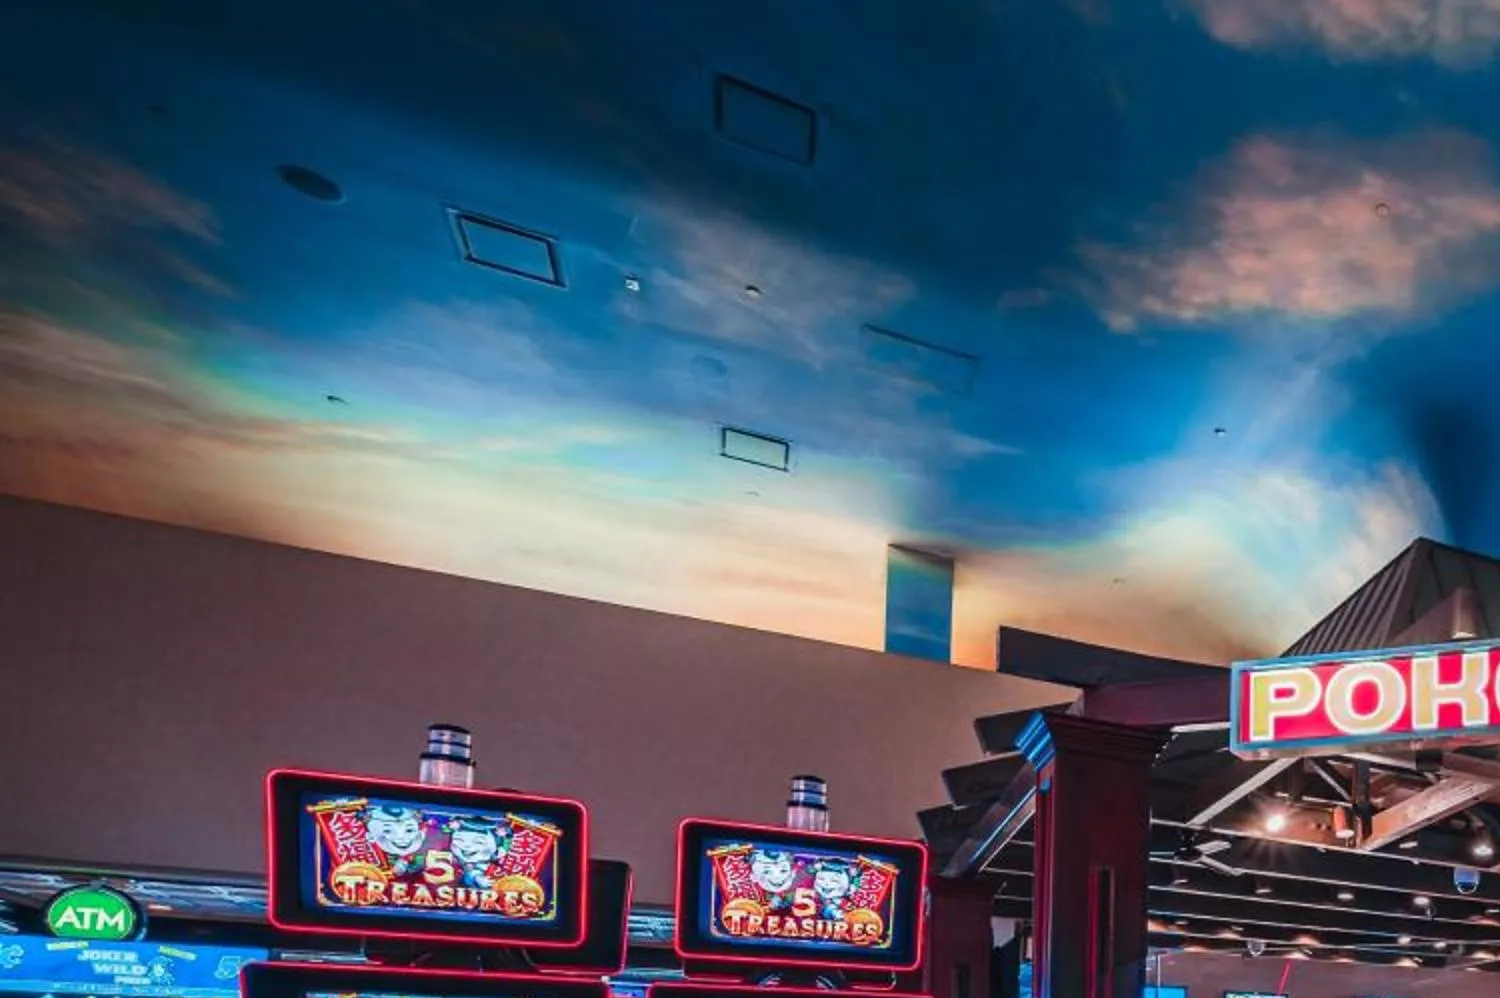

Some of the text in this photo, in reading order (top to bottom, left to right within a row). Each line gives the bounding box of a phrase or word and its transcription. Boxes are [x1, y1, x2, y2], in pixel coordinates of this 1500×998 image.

[424, 850, 455, 885] 5
[337, 875, 541, 912] TREASURES
[792, 887, 817, 917] 5
[55, 907, 126, 931] ATM
[730, 909, 879, 943] TREASURES
[77, 950, 139, 962] JOKER
[91, 963, 149, 976] WILD
